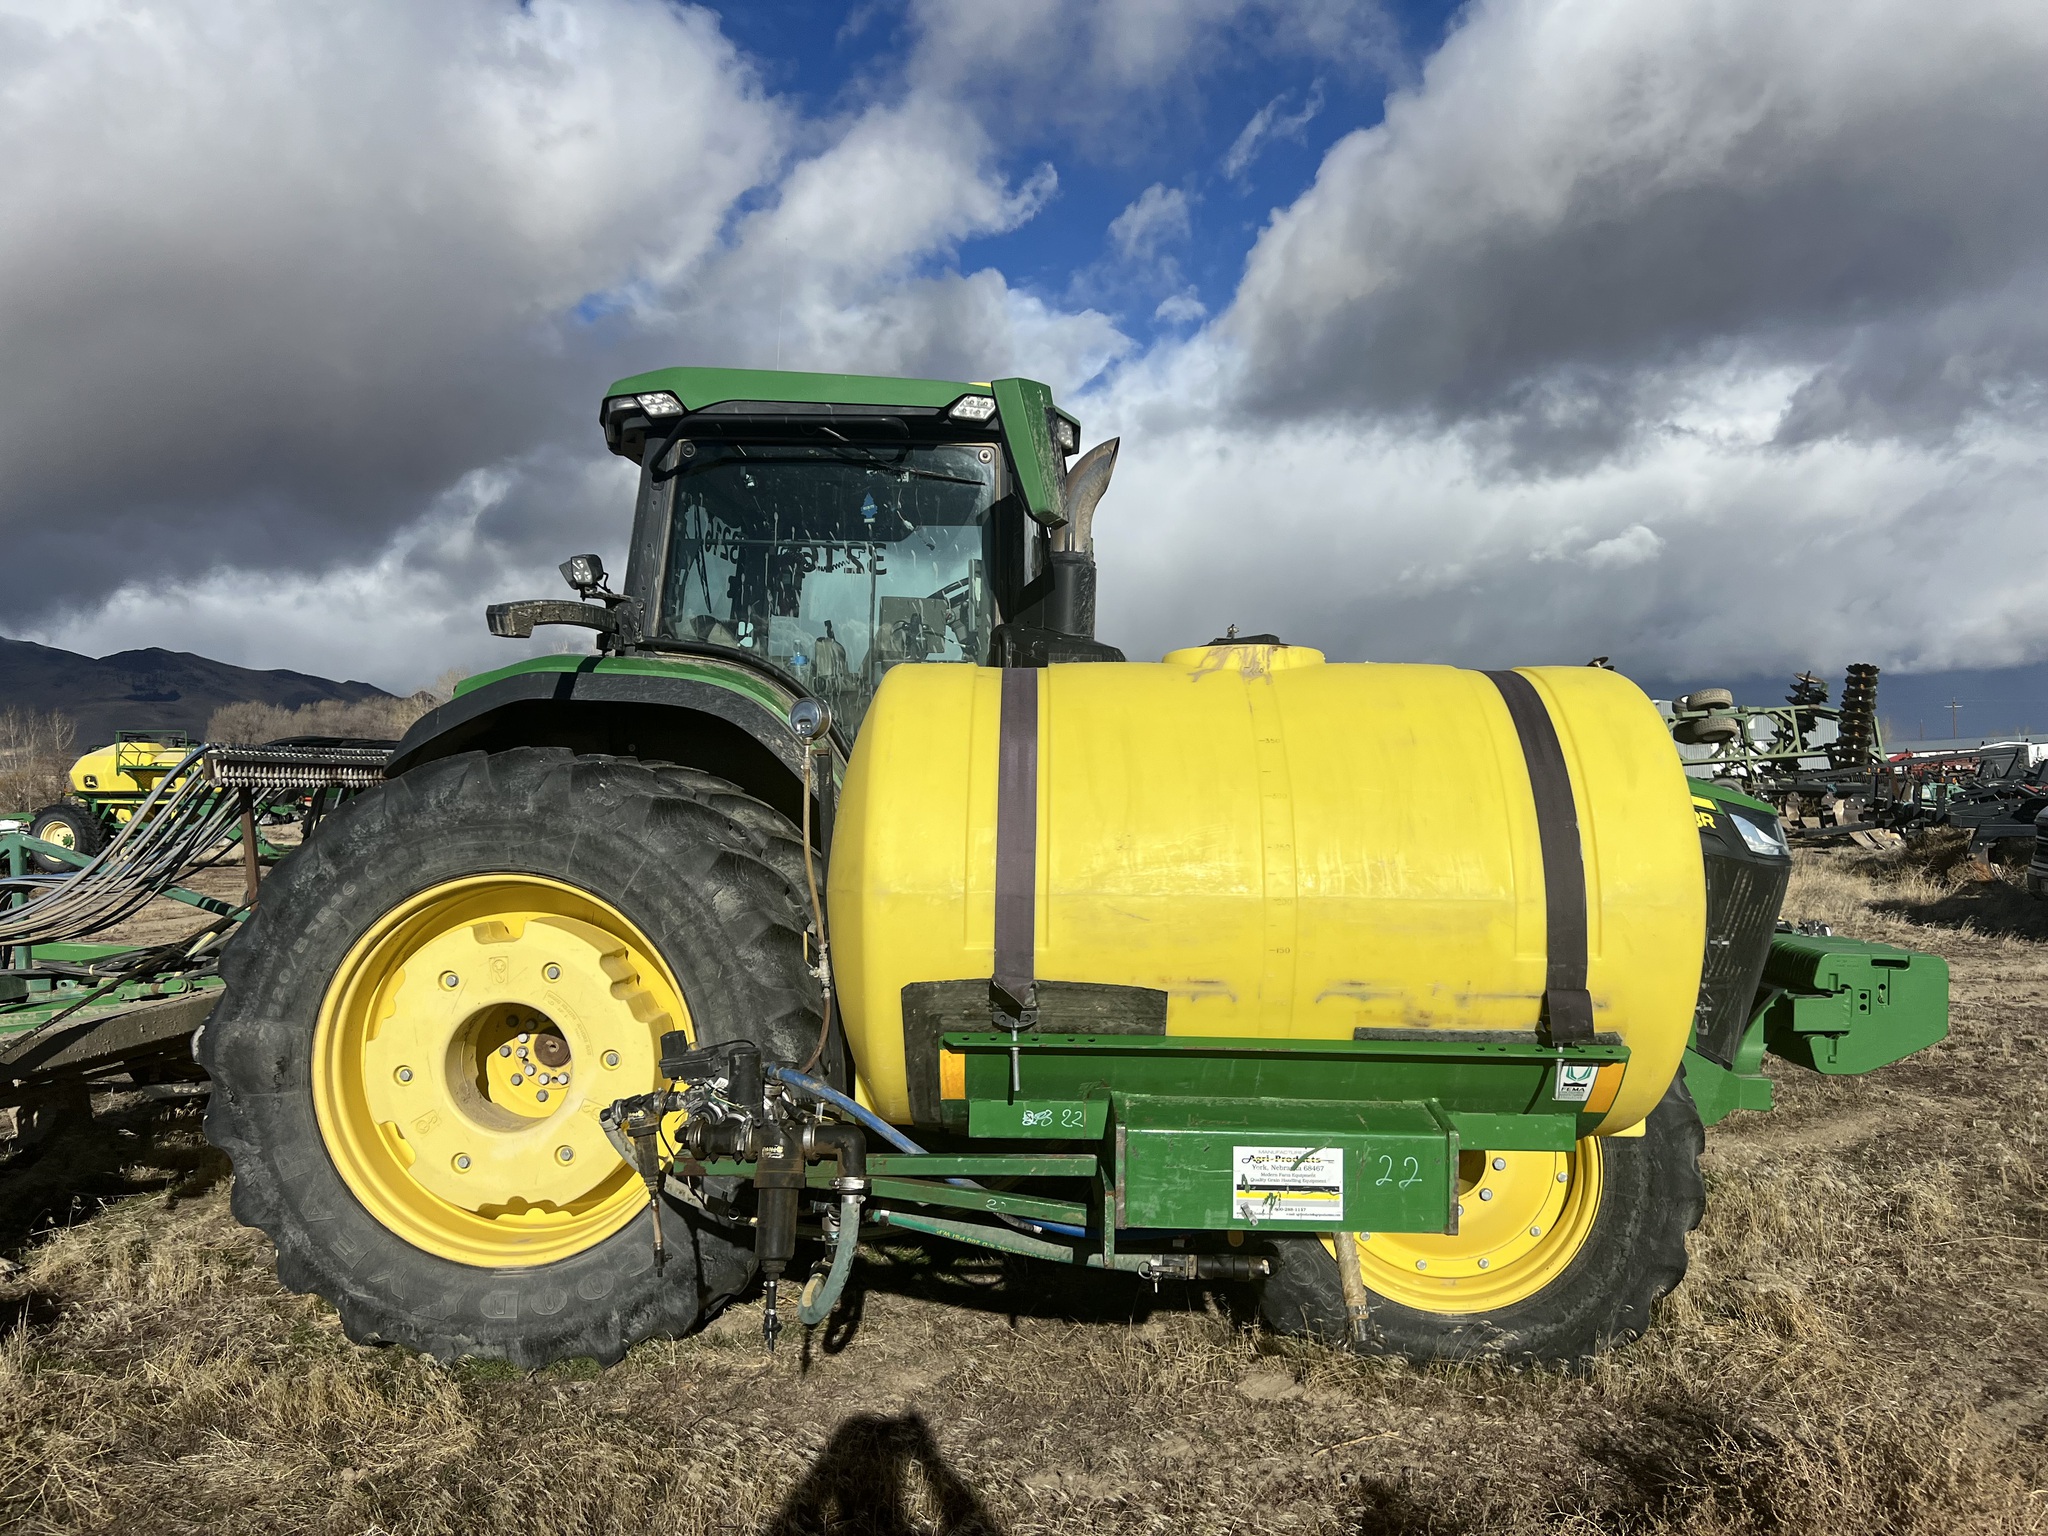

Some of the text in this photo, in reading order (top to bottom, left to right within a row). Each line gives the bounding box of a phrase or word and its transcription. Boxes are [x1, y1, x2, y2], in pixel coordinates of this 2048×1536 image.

[1061, 1109, 1084, 1128] 22
[1241, 1154, 1321, 1164] Agri-Prodcts
[1375, 1154, 1423, 1191] 22
[952, 1233, 966, 1242] PSI
